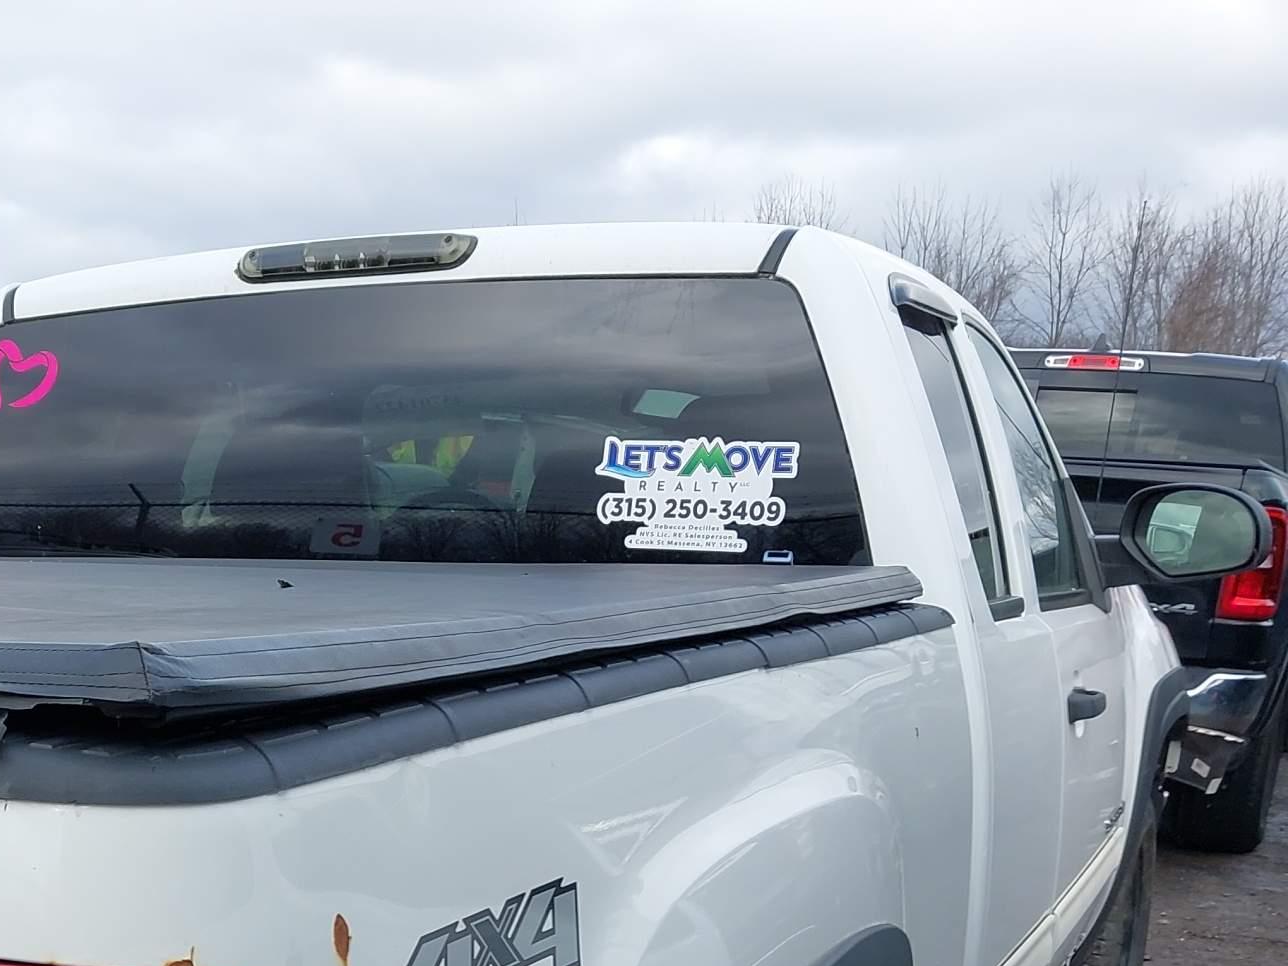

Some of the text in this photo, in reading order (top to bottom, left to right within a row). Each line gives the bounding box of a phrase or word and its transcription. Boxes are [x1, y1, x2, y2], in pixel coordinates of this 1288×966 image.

[639, 480, 738, 493] REALTY
[601, 497, 781, 522] (315) 250-3409
[685, 533, 733, 541] Salesperson
